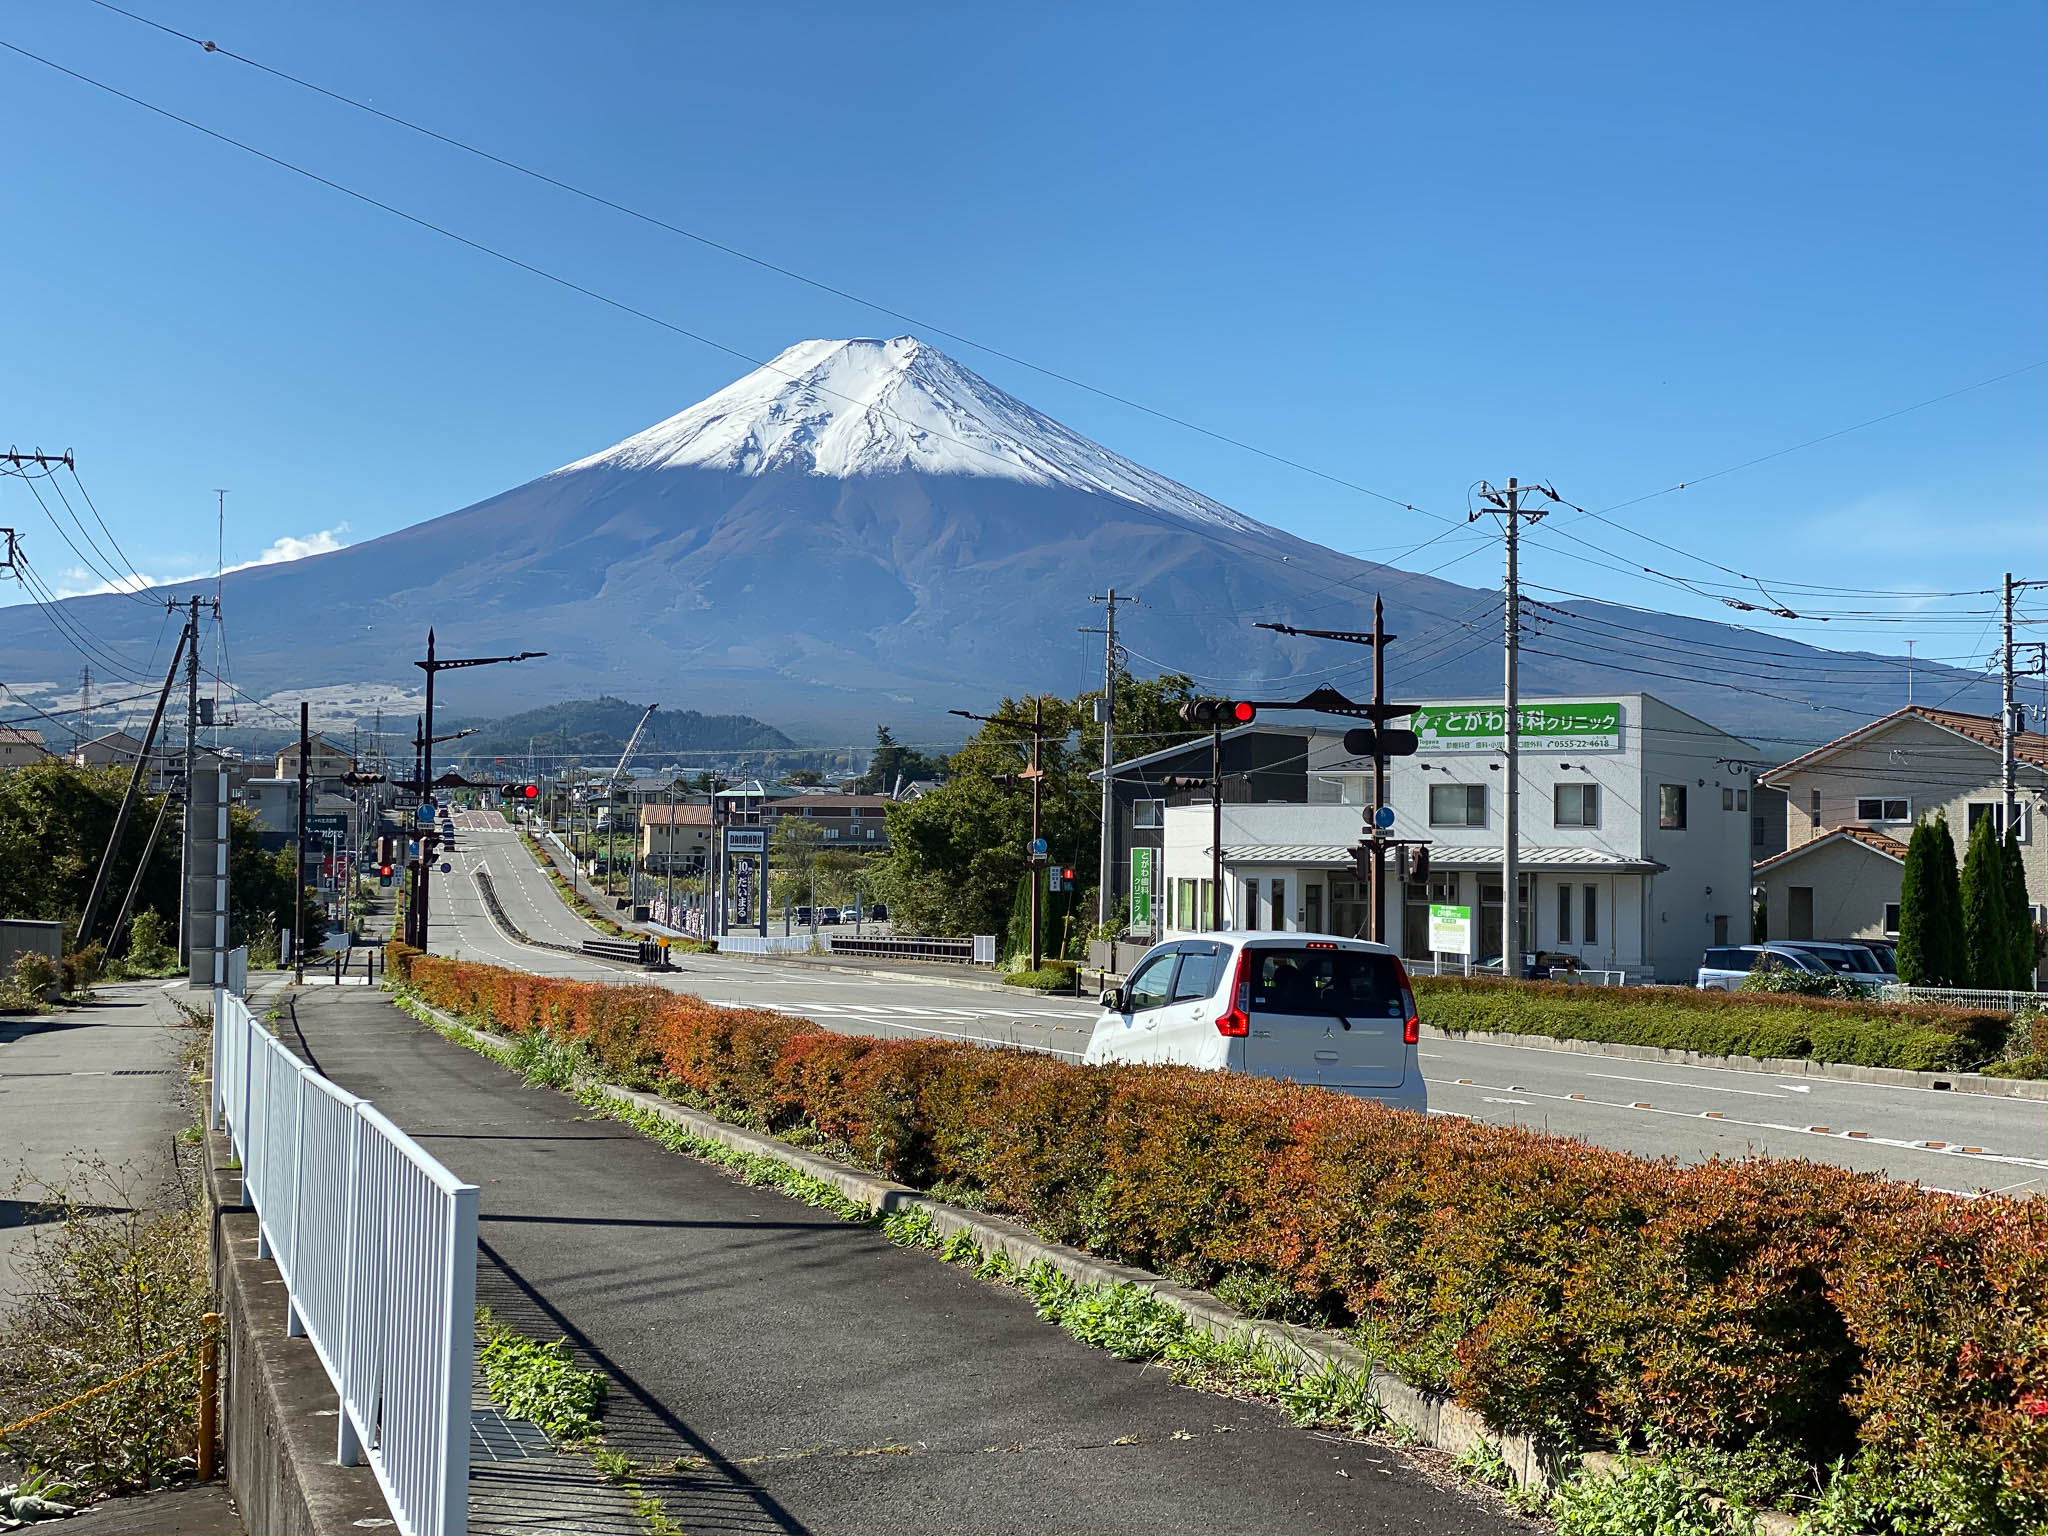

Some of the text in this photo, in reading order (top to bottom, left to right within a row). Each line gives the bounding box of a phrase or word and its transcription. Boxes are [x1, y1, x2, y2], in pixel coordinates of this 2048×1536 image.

[1554, 740, 1609, 748] 0555-22-4618
[730, 835, 762, 844] DAIMARU
[1141, 852, 1149, 895] とがわ歯科
[738, 877, 747, 917] だいまる
